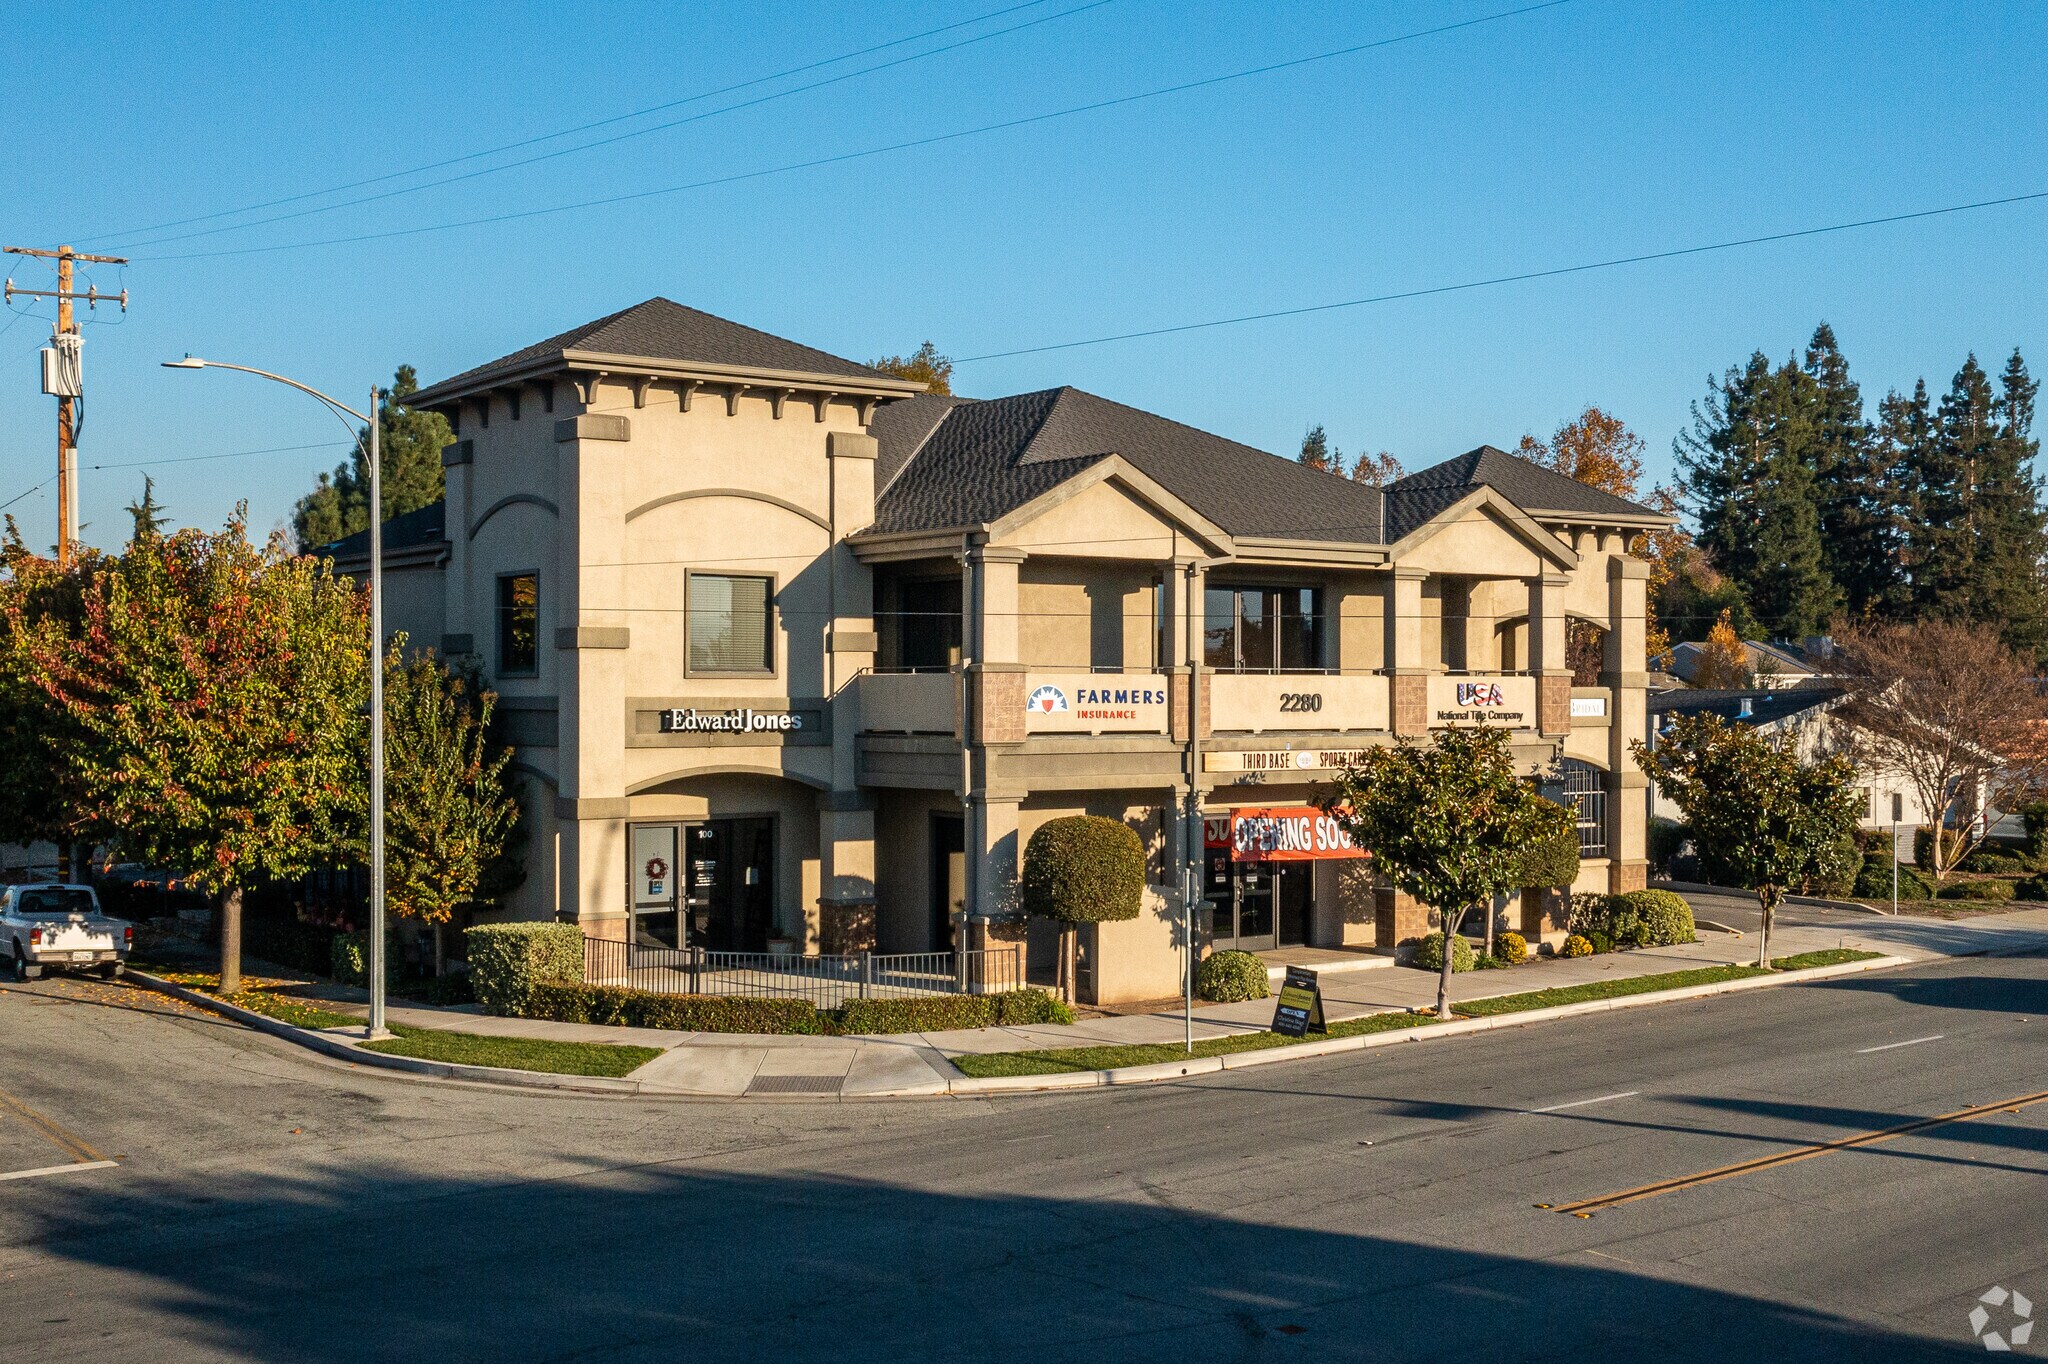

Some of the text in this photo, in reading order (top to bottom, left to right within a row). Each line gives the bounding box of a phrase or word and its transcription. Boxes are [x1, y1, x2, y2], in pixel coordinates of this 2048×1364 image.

[1077, 689, 1165, 704] FARMERS
[1280, 693, 1322, 712] 2280
[1456, 683, 1504, 706] USA
[1077, 710, 1137, 719] INSURANCE
[1437, 710, 1469, 720] National
[1488, 710, 1524, 723] Company
[1242, 753, 1267, 769] THIRD
[1269, 752, 1290, 769] BASE
[698, 830, 713, 839] 100
[1235, 815, 1313, 852] OPENING
